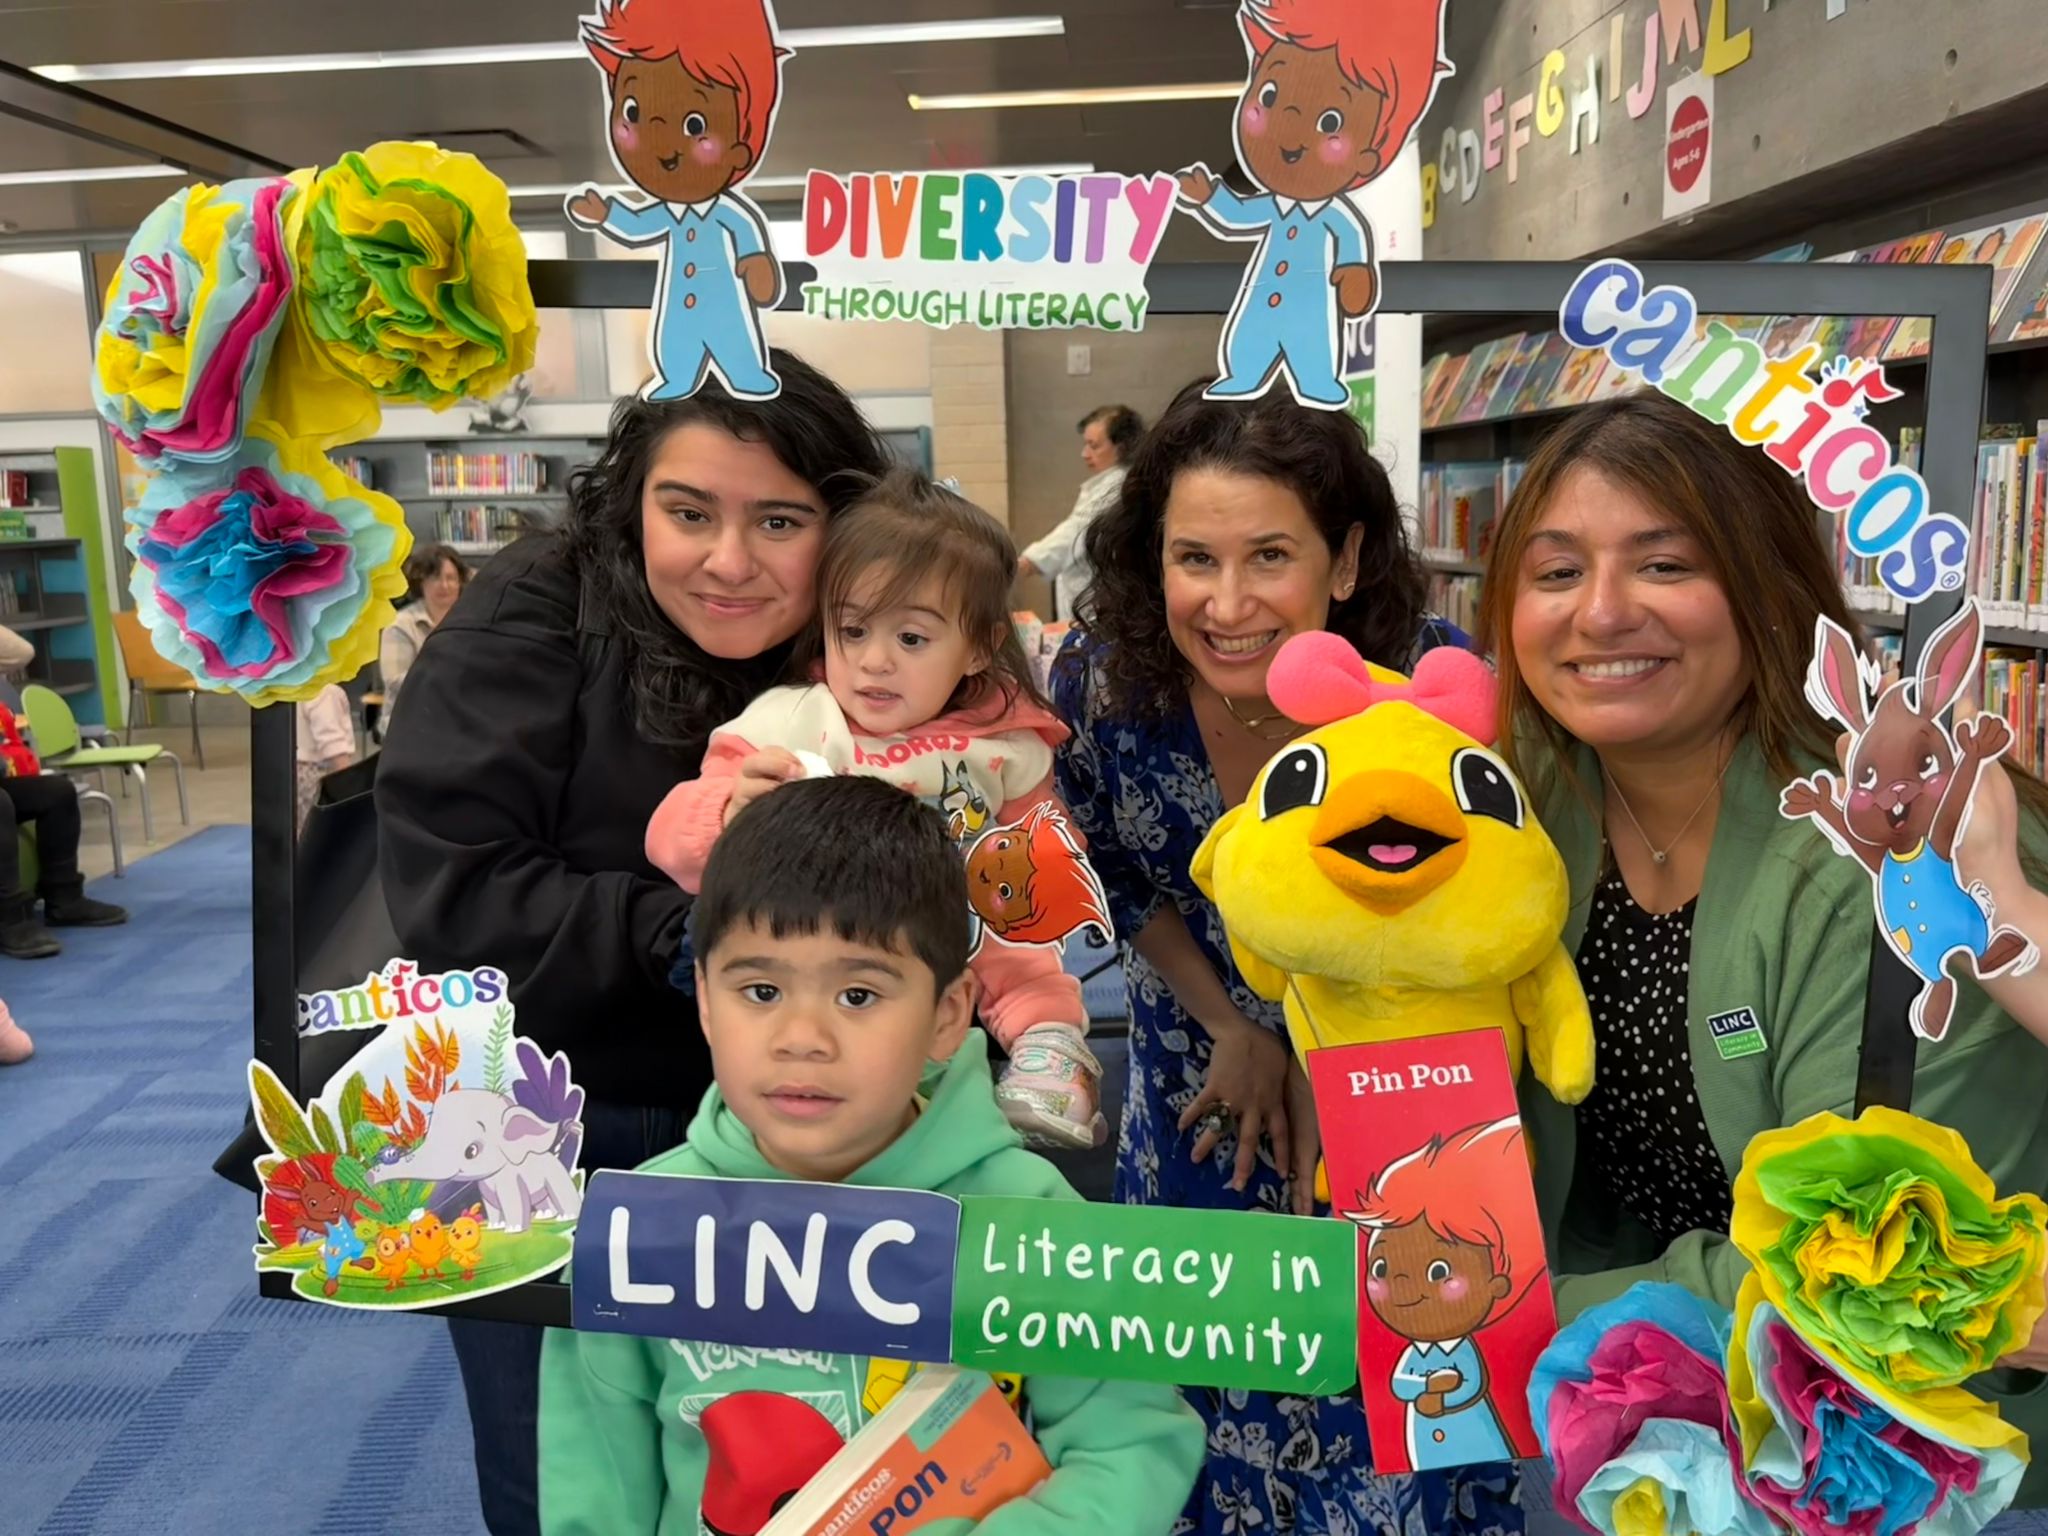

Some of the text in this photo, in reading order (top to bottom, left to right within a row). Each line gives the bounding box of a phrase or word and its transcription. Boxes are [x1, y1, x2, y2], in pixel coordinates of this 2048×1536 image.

[1422, 162, 1438, 229] B
[1440, 126, 1457, 194] C
[1459, 129, 1481, 205] D
[1483, 87, 1504, 172] E
[1508, 93, 1533, 185] F
[1536, 50, 1565, 137] G
[1570, 53, 1600, 155] H
[1609, 13, 1624, 103] I
[1625, 10, 1659, 119] J
[1702, 0, 1752, 78] L
[806, 171, 1174, 264] DIVERSITY
[803, 285, 1147, 330] THROUGH LITERACY
[1563, 263, 1968, 598] canticos
[1712, 1012, 1752, 1033] LINC
[1348, 1063, 1473, 1096] Pin Pon
[608, 1206, 920, 1325] LINC
[983, 1223, 1321, 1298] Literacy in
[982, 1295, 1322, 1375] Community
